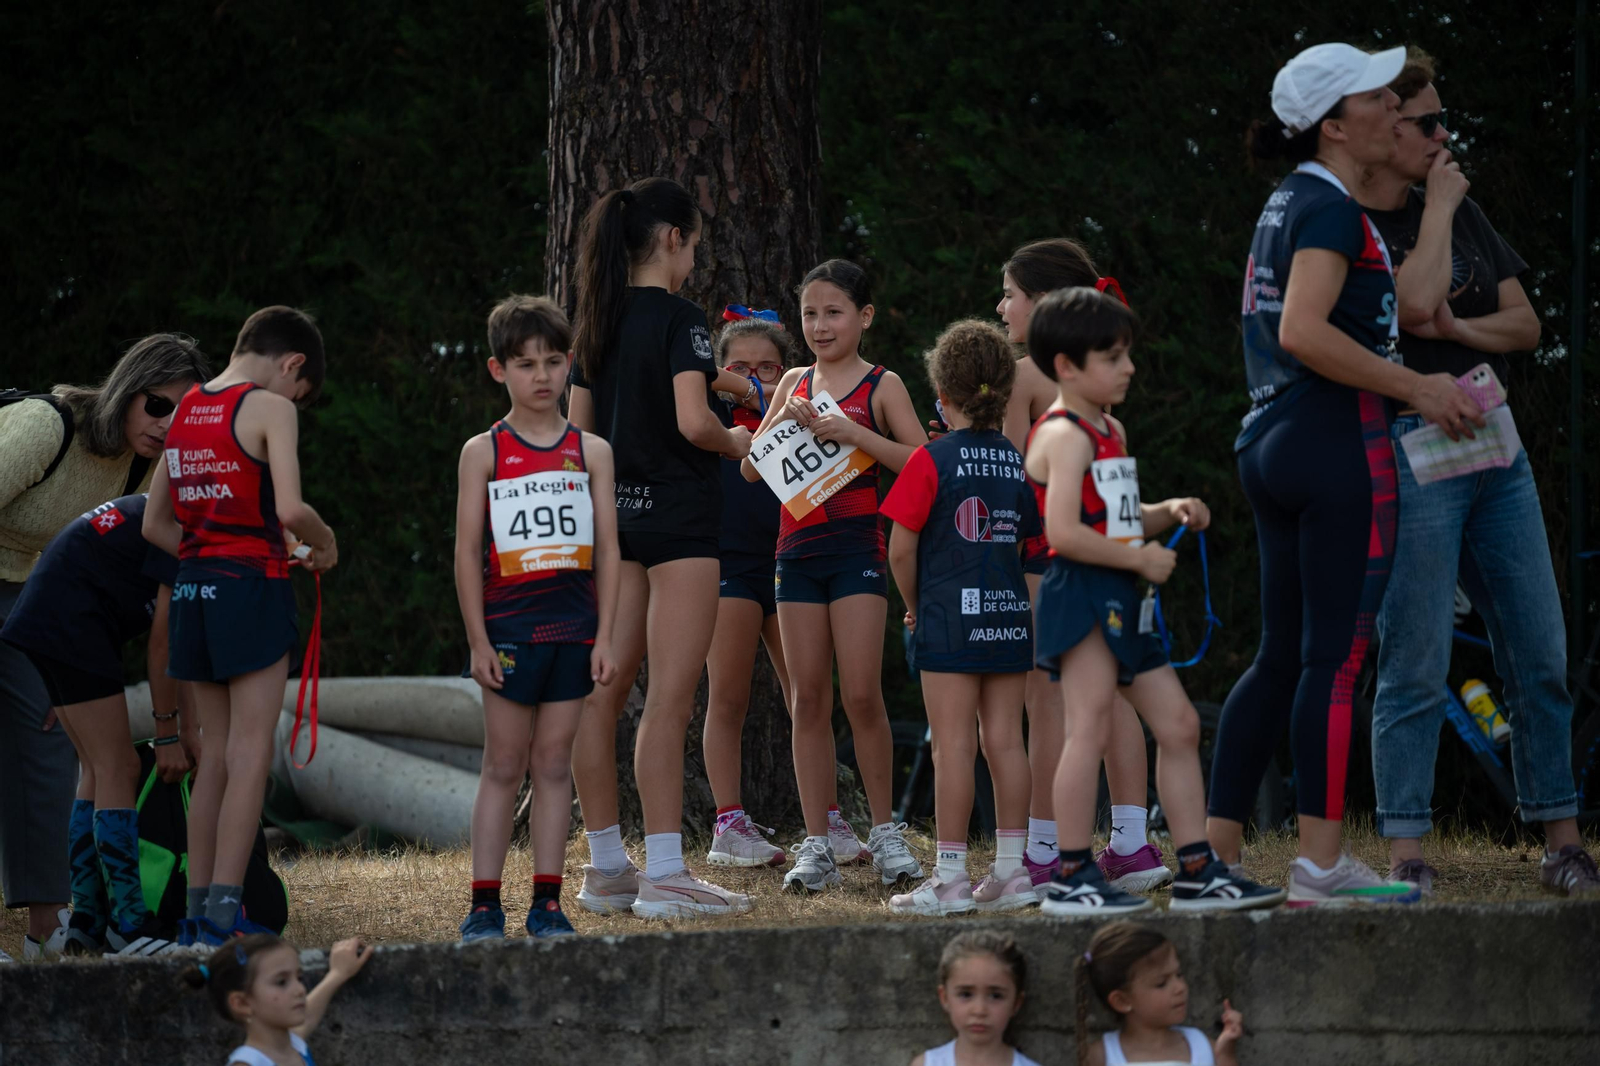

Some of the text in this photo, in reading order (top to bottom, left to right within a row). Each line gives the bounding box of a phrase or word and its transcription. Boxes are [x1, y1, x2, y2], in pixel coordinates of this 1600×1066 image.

[749, 401, 830, 463] La Regn
[183, 448, 216, 462] XUNTA
[781, 435, 841, 485] 466
[960, 446, 1022, 465] OURENSE
[956, 463, 1026, 482] ATLETISMO
[493, 486, 520, 501] La
[810, 467, 860, 507] telemiño
[1119, 493, 1141, 528] 44
[508, 504, 577, 540] 496
[521, 556, 579, 573] telemiño
[984, 590, 1017, 600] XUNTA
[984, 602, 998, 612] DE
